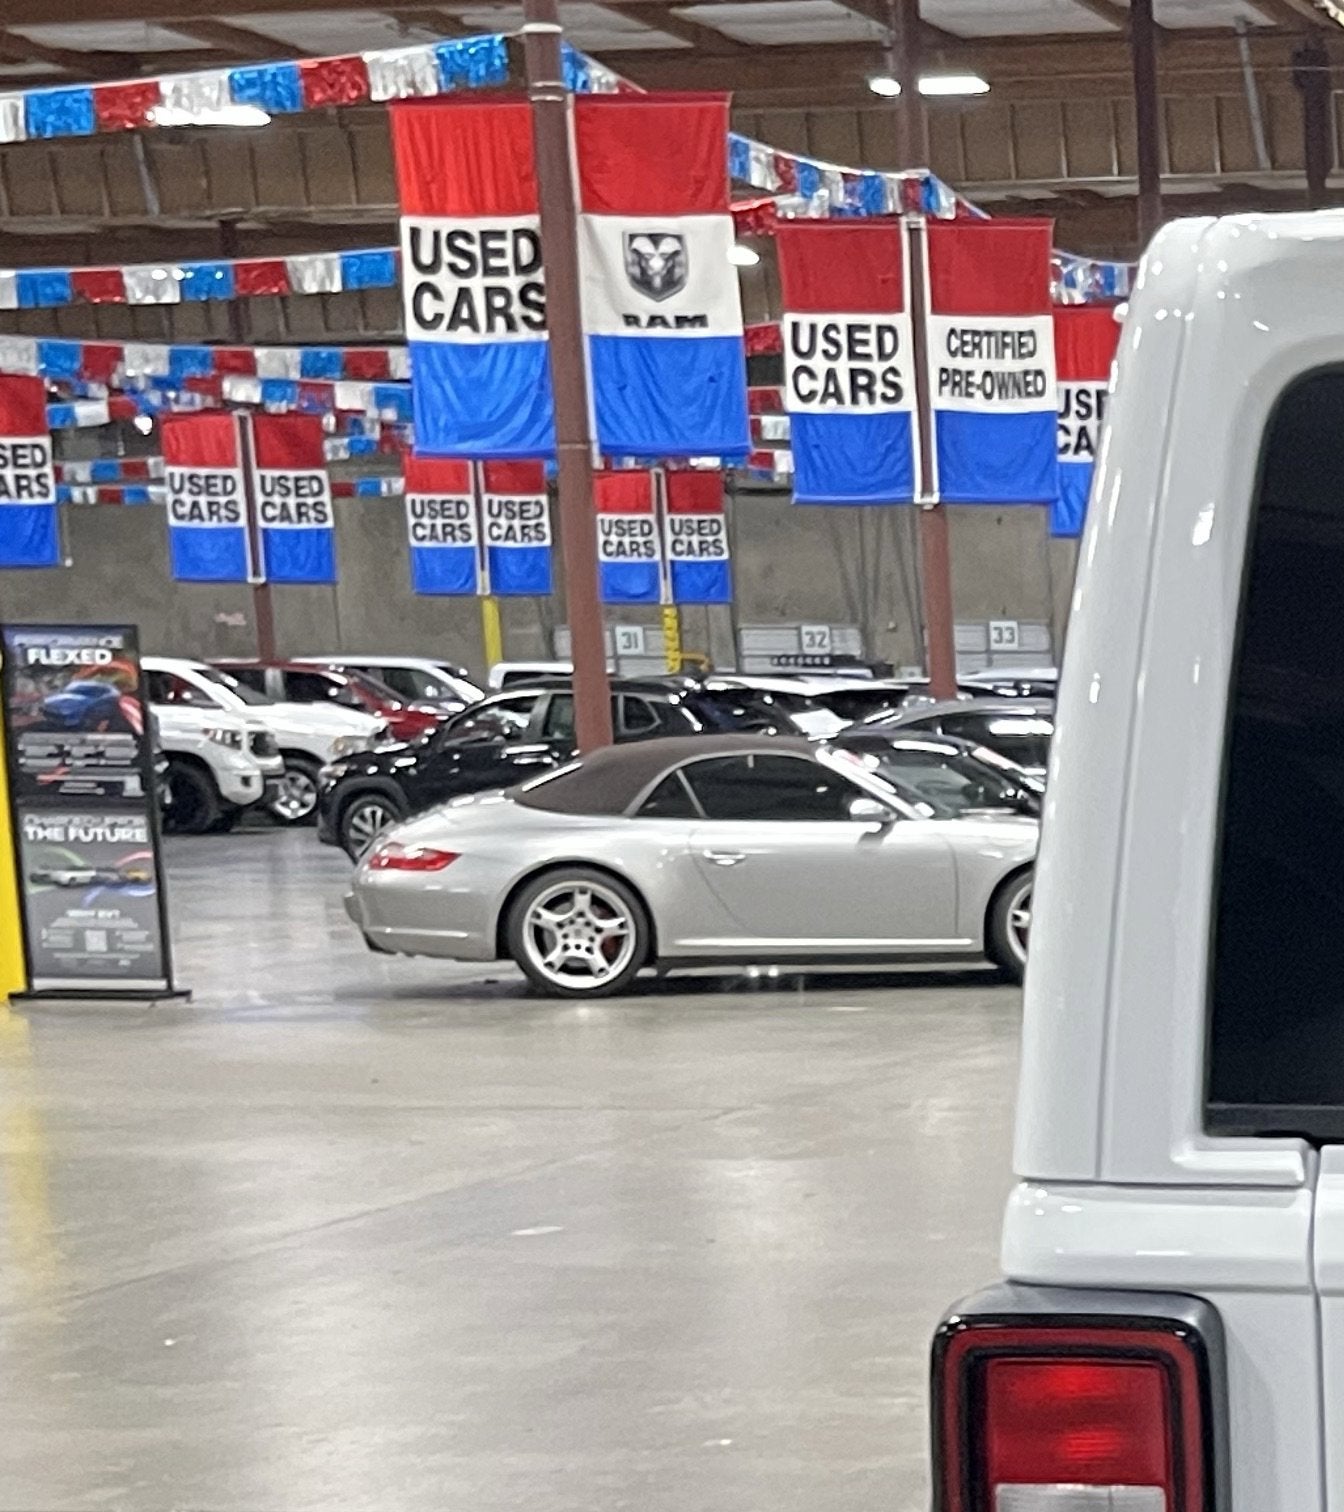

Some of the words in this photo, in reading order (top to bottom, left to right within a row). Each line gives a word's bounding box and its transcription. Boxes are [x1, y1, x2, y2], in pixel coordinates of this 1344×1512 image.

[409, 226, 542, 278] USED
[411, 281, 547, 333] CARS
[621, 312, 709, 329] RAM
[791, 323, 900, 361] USED
[946, 328, 1036, 360] CERTIFIED
[792, 365, 904, 406] CARS
[937, 367, 1047, 401] PRE-OWNED
[0, 443, 47, 469] SED
[0, 473, 50, 499] ARS
[168, 473, 237, 497] USED
[260, 473, 325, 498] USED
[171, 499, 241, 523] CARS
[260, 500, 328, 524] CARS
[411, 500, 469, 520] USED
[487, 500, 544, 520] USED
[412, 522, 472, 543] CARS
[488, 522, 547, 543] CARS
[600, 518, 653, 537] USED
[669, 518, 722, 537] USED
[602, 540, 656, 558] CARS
[671, 539, 725, 557] CARS
[620, 631, 639, 650] 31
[805, 629, 828, 649] 32
[993, 625, 1016, 645] 33
[27, 648, 112, 665] FLEXED
[24, 826, 65, 841] THE
[68, 827, 148, 843] FUTURE
